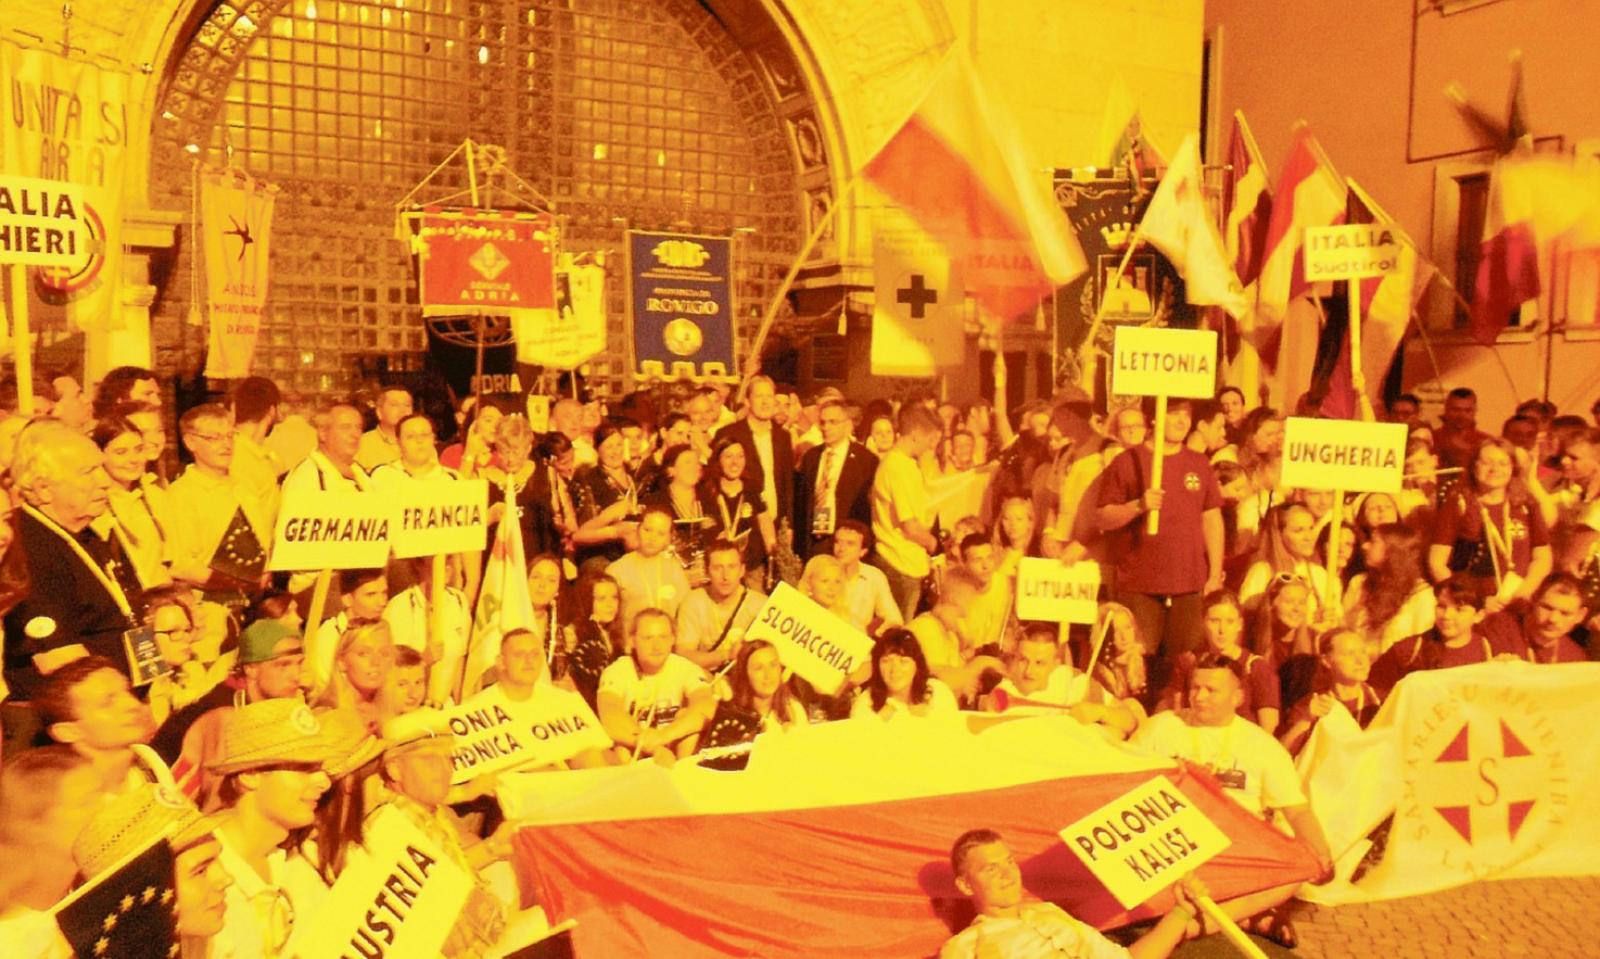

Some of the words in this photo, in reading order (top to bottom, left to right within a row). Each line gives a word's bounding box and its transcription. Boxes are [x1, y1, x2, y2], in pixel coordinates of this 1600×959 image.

[1312, 230, 1396, 251] ITALIA
[459, 289, 520, 302] ADRIA
[646, 297, 719, 315] ROVIGO
[1119, 350, 1210, 374] LETTONIA
[1289, 442, 1398, 469] UNGHERIA
[284, 517, 389, 542] GERMANIA
[403, 504, 482, 531] FRANCIA
[761, 605, 855, 676] SLOVACCHIA
[1476, 757, 1500, 807] S
[1075, 788, 1187, 861] POLONIA
[1124, 826, 1199, 882] KALISZ
[340, 845, 436, 959] USTRIA
